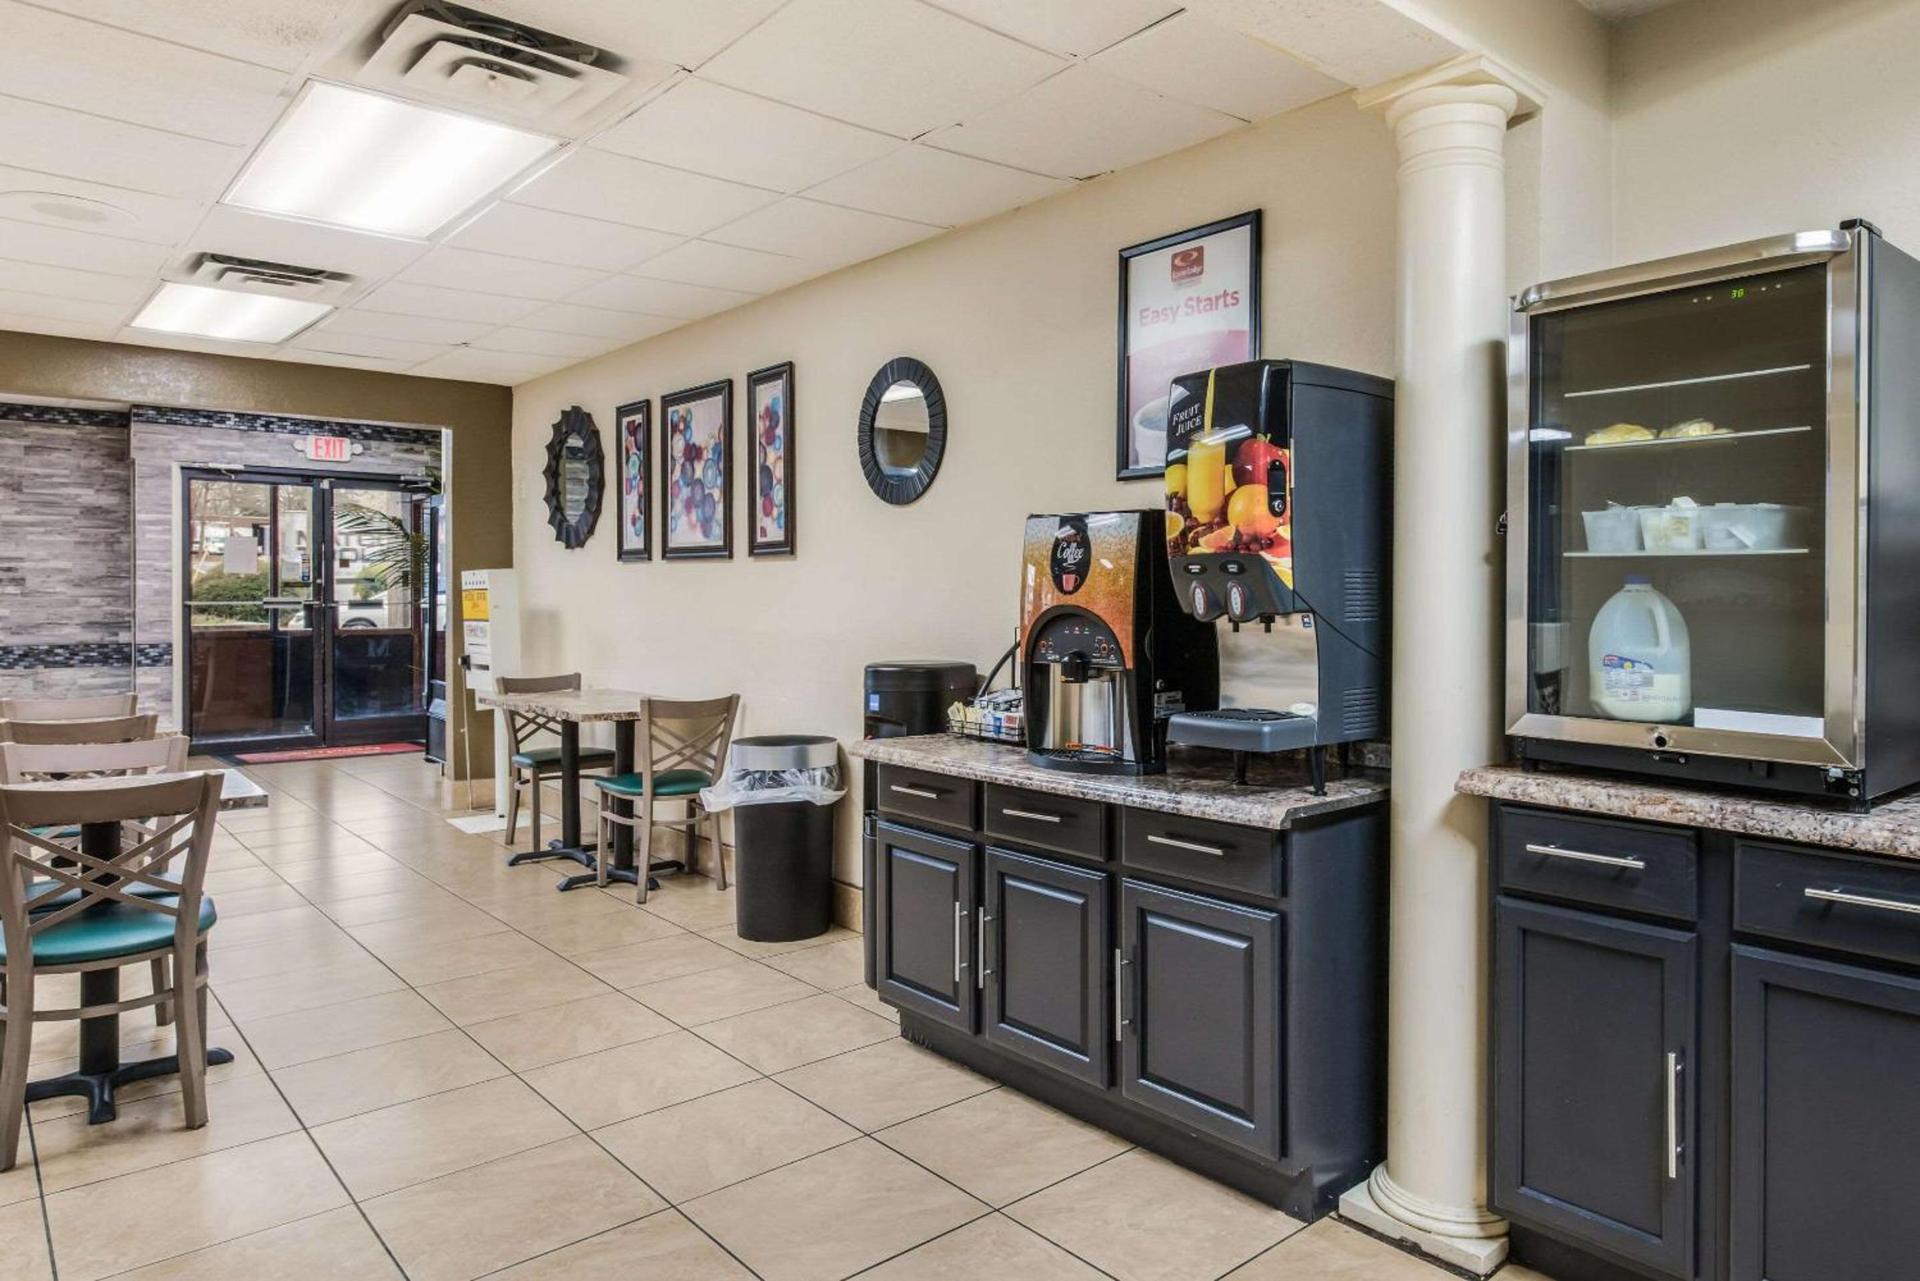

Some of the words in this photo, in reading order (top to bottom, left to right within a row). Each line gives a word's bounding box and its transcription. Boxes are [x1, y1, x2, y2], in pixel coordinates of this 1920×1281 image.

[1139, 304, 1180, 326] Easy
[1184, 288, 1240, 317] Starts
[1172, 402, 1200, 426] FRUIT
[1175, 415, 1202, 436] JUICE
[314, 437, 346, 460] EXIT
[1057, 541, 1084, 564] Coffee
